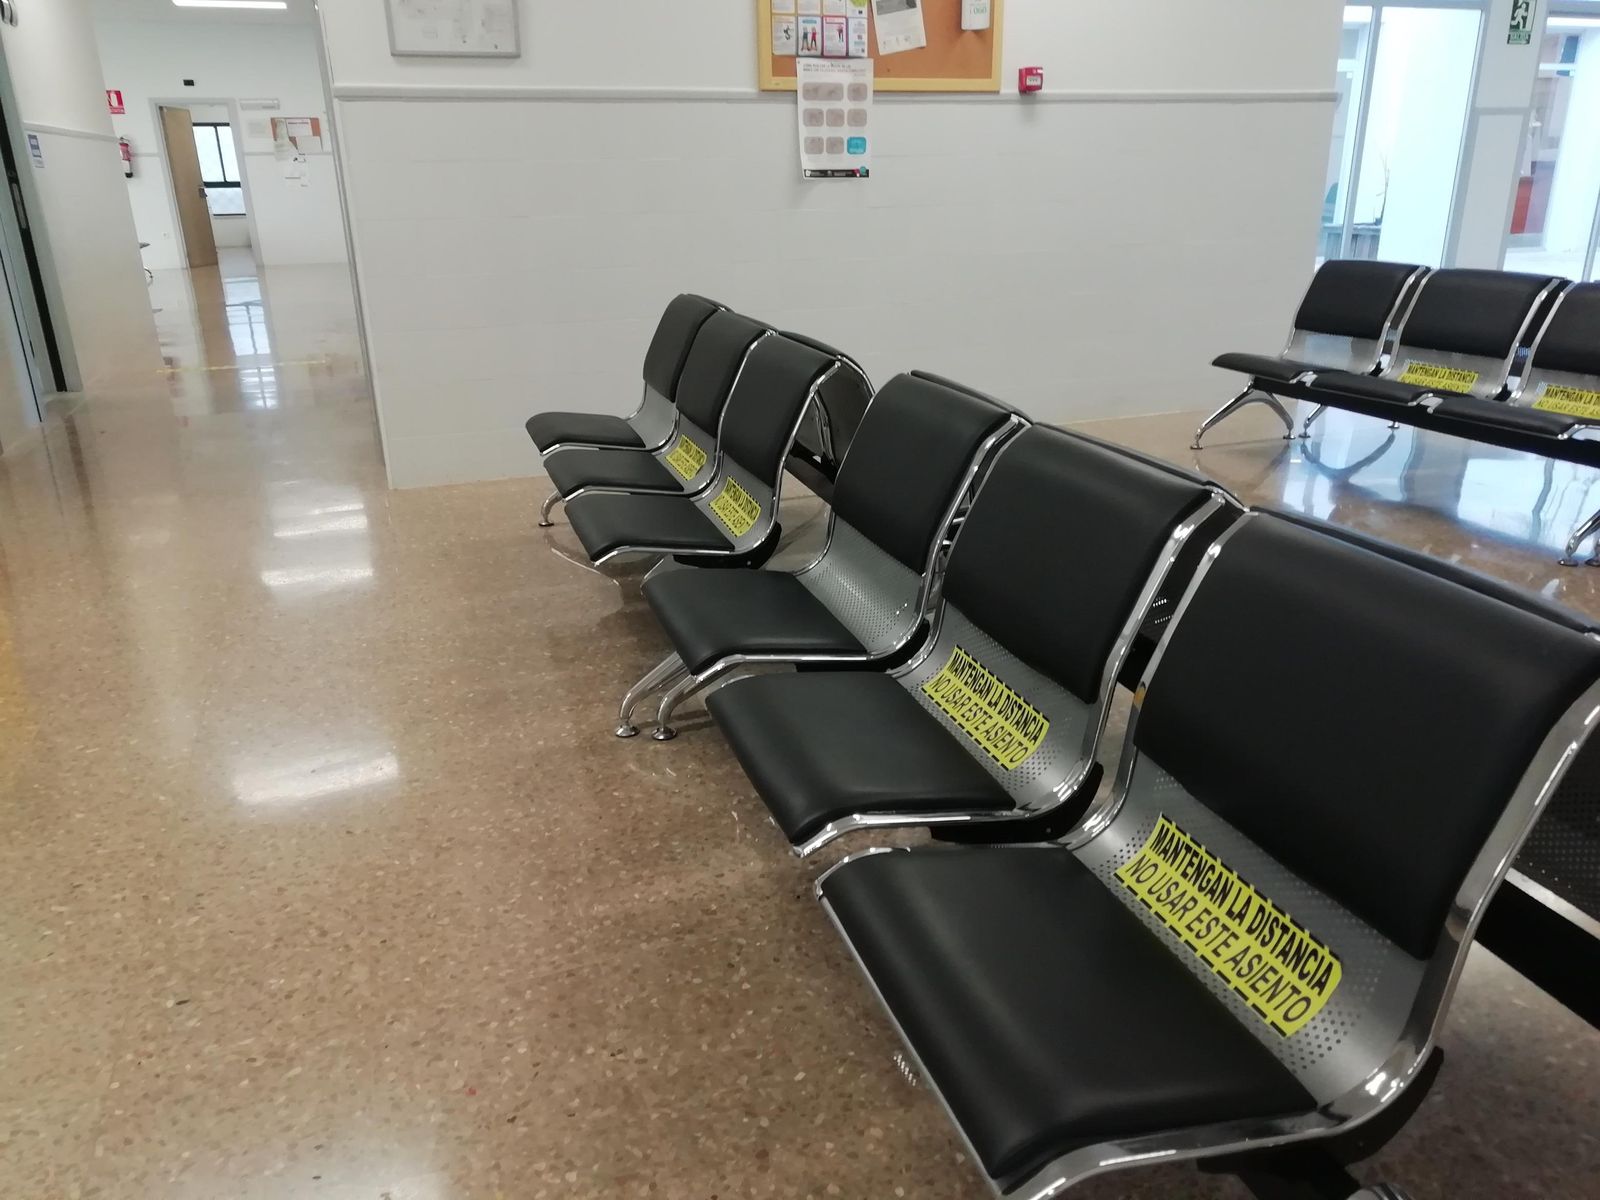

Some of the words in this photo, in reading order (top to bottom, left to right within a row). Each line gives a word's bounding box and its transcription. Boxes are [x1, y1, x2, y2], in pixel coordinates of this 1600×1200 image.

[929, 674, 951, 693] NO
[940, 684, 972, 714] USAR
[960, 703, 993, 731] ESTE
[980, 721, 1029, 763] ASIENTO
[947, 650, 995, 702] MANTENGAN
[987, 685, 1005, 711] LA
[997, 694, 1044, 746] DISTANCIA
[1125, 854, 1159, 884] NO
[1147, 872, 1199, 921] USAR
[1185, 907, 1240, 958] ESTE
[1223, 946, 1312, 1023] ASIENTO
[1149, 823, 1234, 906] MANTENGAN
[1225, 887, 1253, 927] LA
[1247, 905, 1334, 997] DISTANCIA
